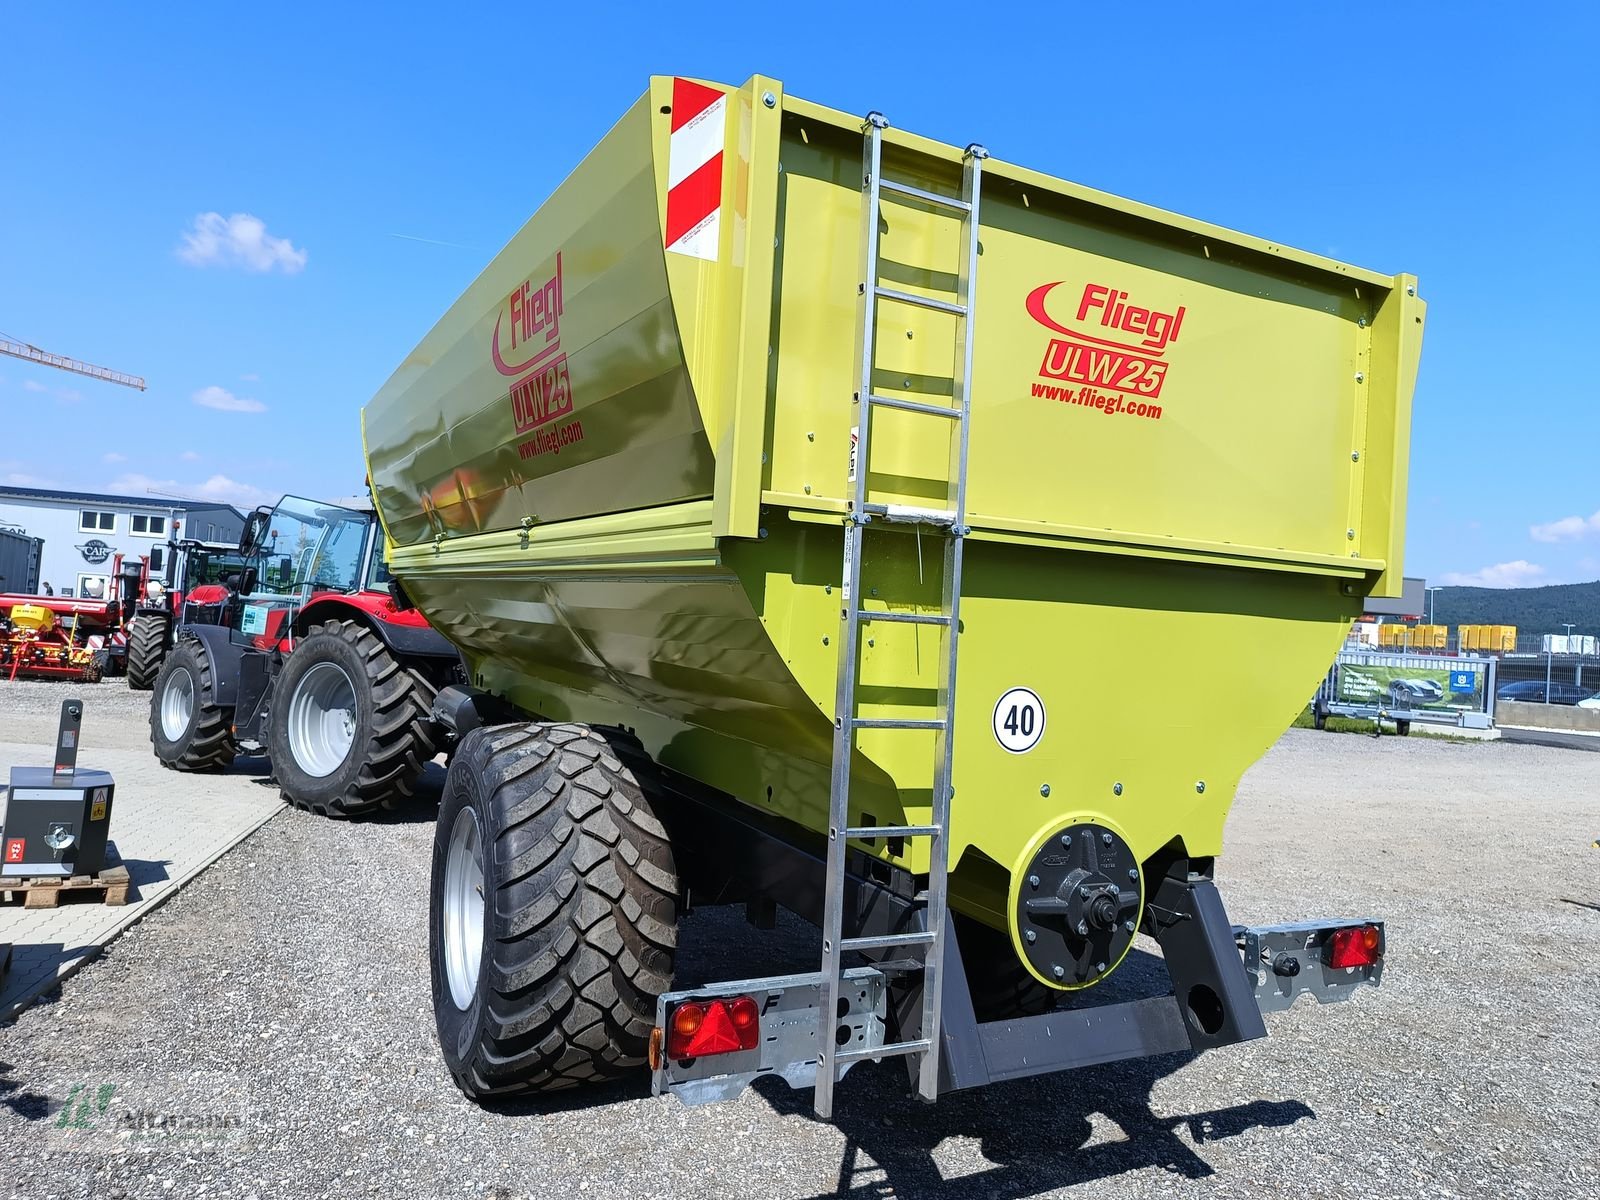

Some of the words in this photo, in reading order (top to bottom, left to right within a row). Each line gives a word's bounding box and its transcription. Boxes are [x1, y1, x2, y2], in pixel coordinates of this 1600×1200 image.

[510, 251, 563, 350] Fliegl
[1076, 283, 1186, 349] Fliegl
[1031, 383, 1163, 419] www.fliegl.com
[517, 421, 584, 460] www.fliegl.com
[84, 546, 107, 556] CAR
[1003, 704, 1035, 736] 40
